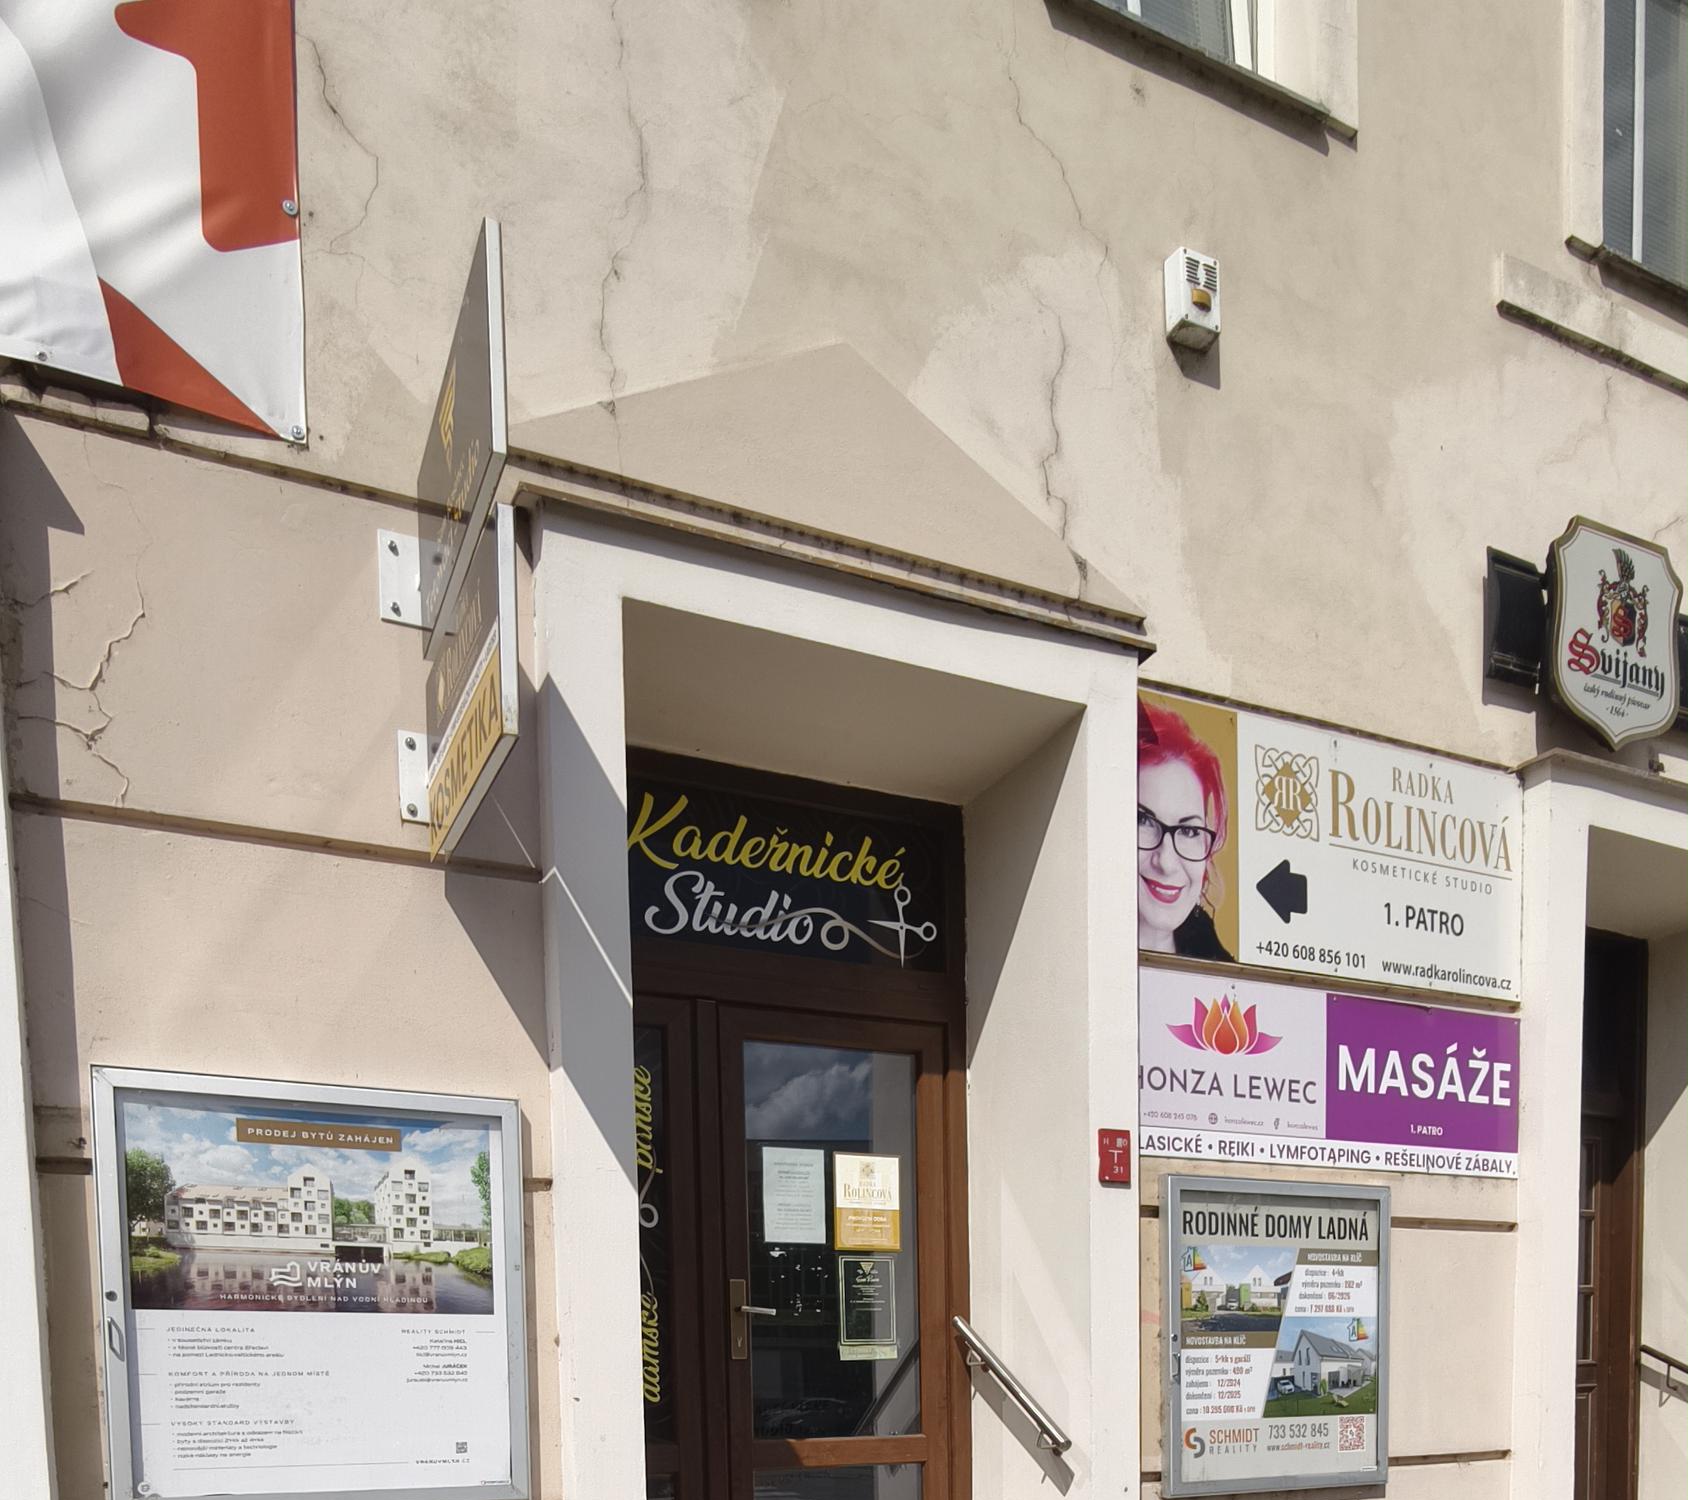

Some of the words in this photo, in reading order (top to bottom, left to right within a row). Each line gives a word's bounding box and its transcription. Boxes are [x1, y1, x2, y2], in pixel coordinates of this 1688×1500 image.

[1568, 628, 1665, 700] Svijany
[430, 674, 499, 845] KOSMETIKA
[1392, 767, 1454, 805] RADKA
[1329, 768, 1512, 872] ROLINCOVÁ
[627, 792, 906, 890] Kadeřnické
[1352, 858, 1438, 886] KOSMETICKÉ
[1445, 874, 1493, 895] STUDIO
[644, 870, 814, 945] Studio
[1384, 902, 1400, 927] 1.
[1405, 905, 1465, 937] PATRO
[1256, 940, 1289, 958] +420
[1292, 944, 1316, 962] 608
[1318, 949, 1341, 966] 856
[1345, 952, 1366, 969] 101
[1382, 959, 1512, 991] www.radkarolincova.cz
[1233, 1074, 1318, 1105] LEWEC
[1337, 1042, 1512, 1107] MASÁŽE
[247, 1127, 297, 1139] PRODEJ
[301, 1130, 334, 1141] BYTŮ
[338, 1133, 394, 1145] ZAHÁJEN
[1417, 1125, 1444, 1138] PATRO
[1217, 1139, 1255, 1157] REIKI
[1269, 1143, 1371, 1165] LYMFOTAPING
[1384, 1147, 1463, 1172] REŠELINOVÉ
[1182, 1206, 1260, 1238] RODINNÉ
[1264, 1215, 1313, 1239] DOMY
[1317, 1211, 1369, 1241] LADNÁ
[307, 1259, 382, 1274] VRÁNŮV
[307, 1276, 358, 1289] MLÝN
[1208, 1428, 1260, 1445] SCHMIDT
[1268, 1424, 1286, 1440] 733
[1289, 1423, 1308, 1439] 532
[1311, 1422, 1330, 1438] 845
[1208, 1445, 1258, 1455] REALITY
